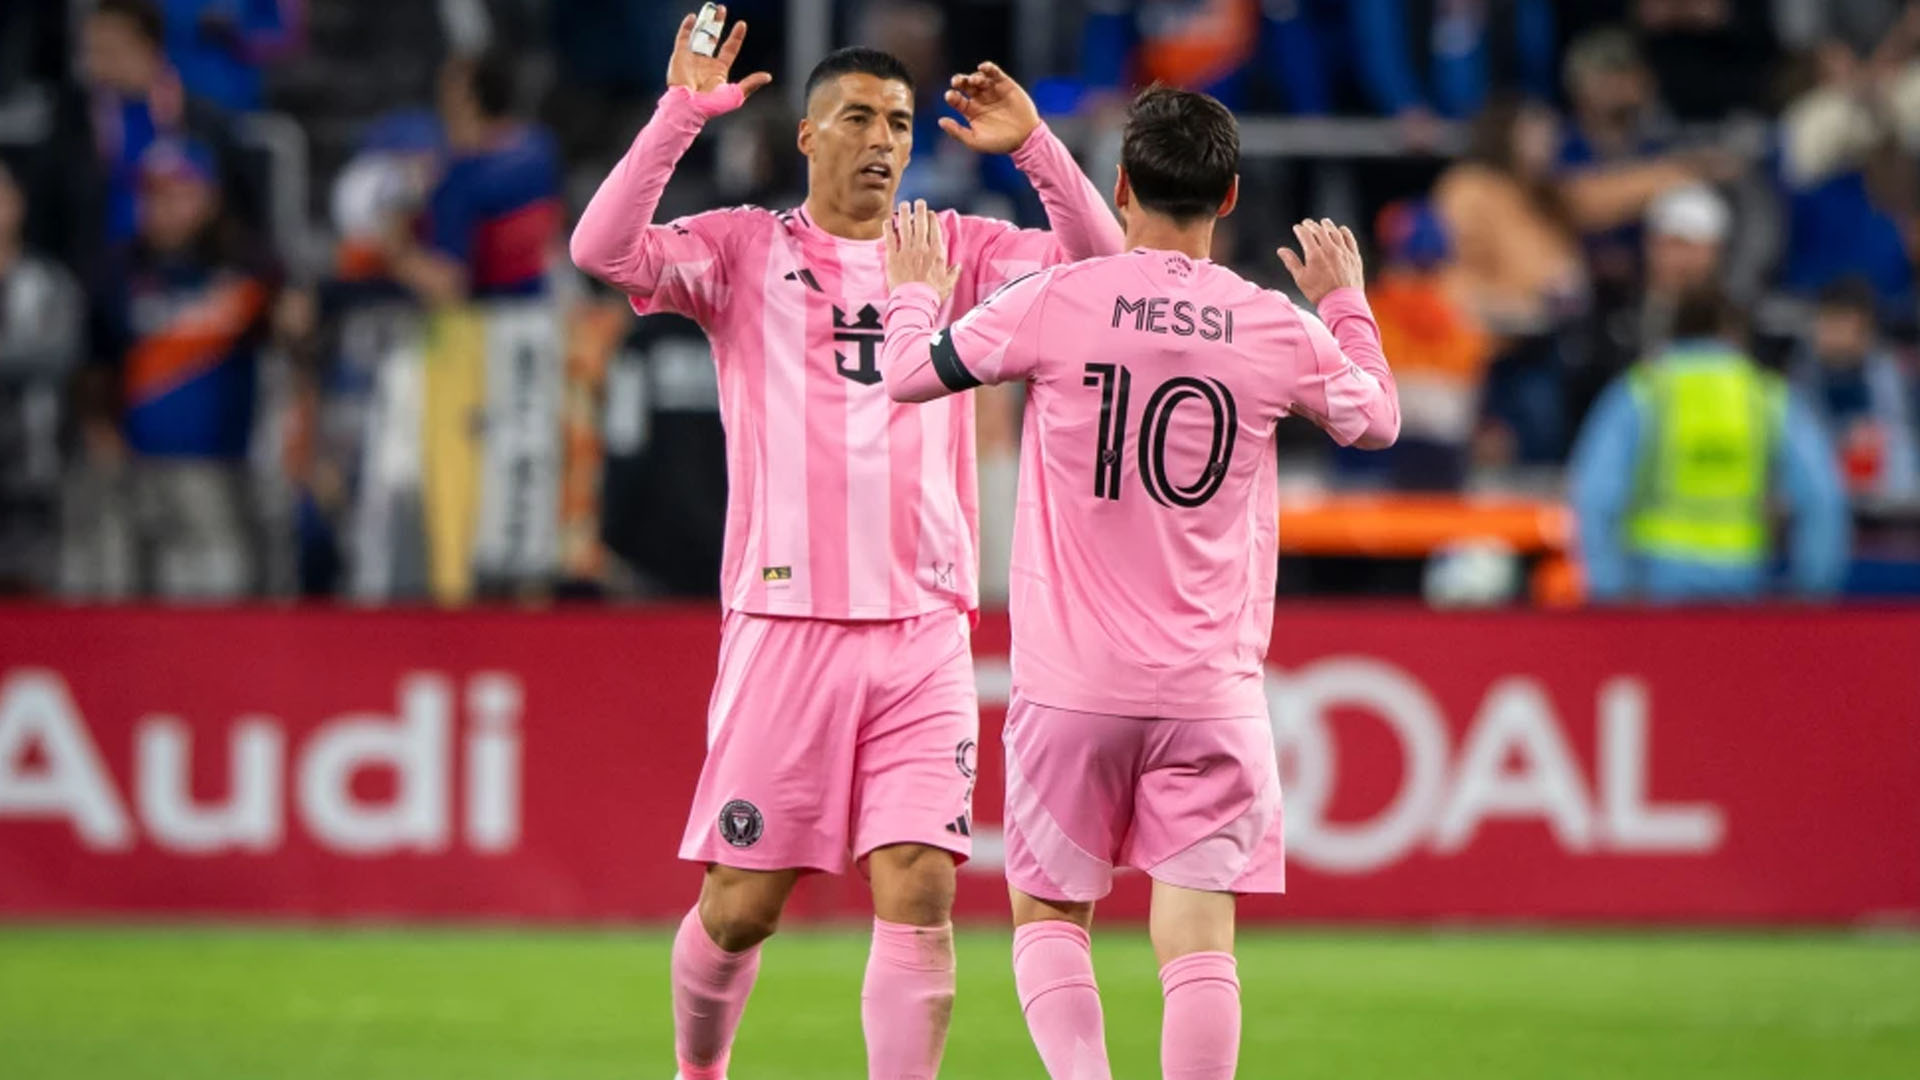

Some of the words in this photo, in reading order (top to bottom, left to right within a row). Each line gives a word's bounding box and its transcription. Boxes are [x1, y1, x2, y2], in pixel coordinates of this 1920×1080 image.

[1112, 296, 1233, 343] MESSI
[1083, 362, 1237, 507] 10
[0, 668, 523, 855] Audi
